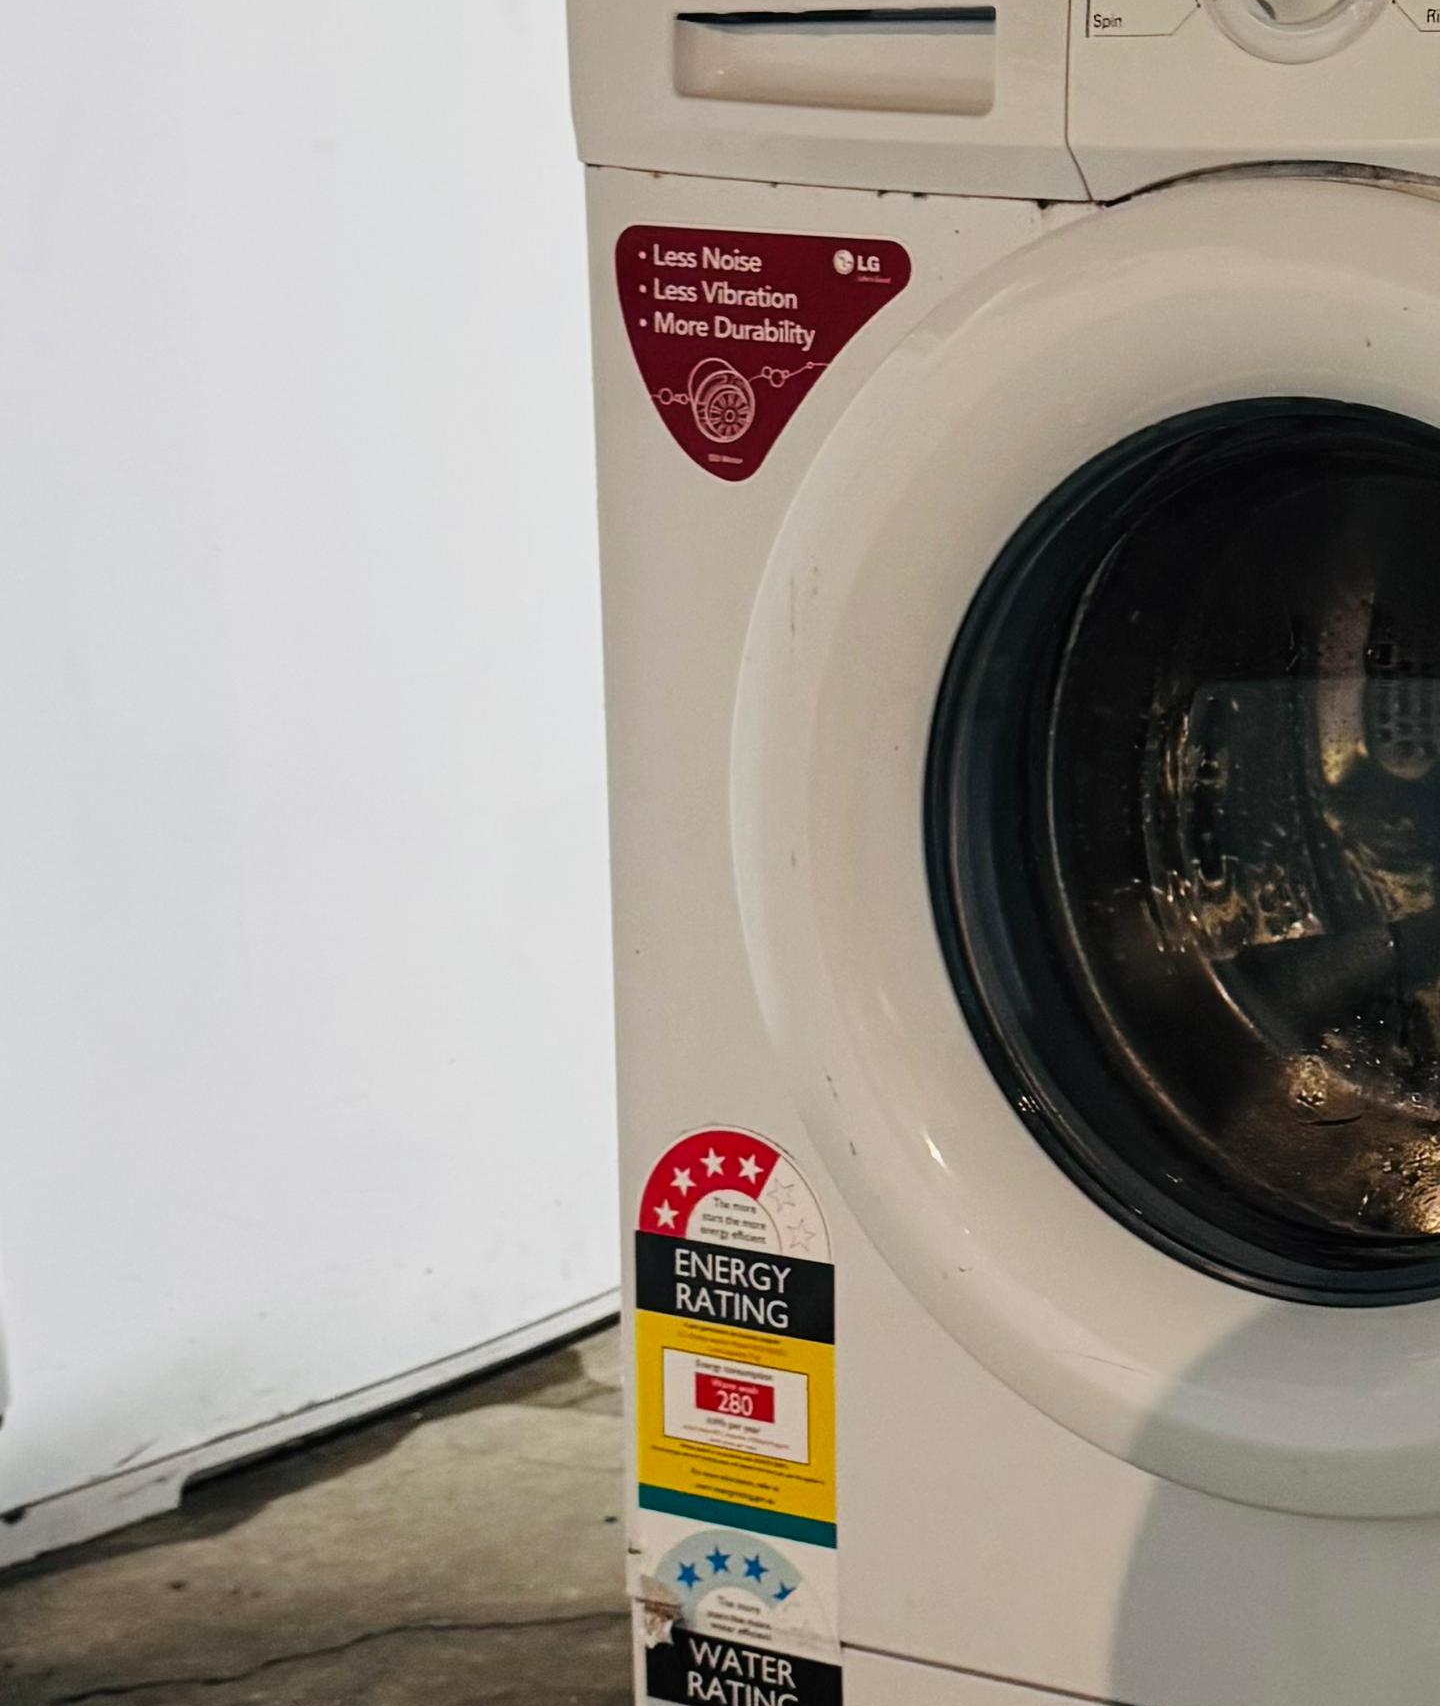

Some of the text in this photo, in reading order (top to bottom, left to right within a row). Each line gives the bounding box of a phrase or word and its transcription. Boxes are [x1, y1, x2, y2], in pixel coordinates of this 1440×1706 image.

[1093, 14, 1122, 29] Spin
[653, 243, 762, 273] Less Noise
[857, 255, 880, 272] LG
[653, 277, 798, 310] Less Vibration
[654, 311, 816, 351] More Durability
[713, 1196, 756, 1214] The more
[742, 1220, 766, 1230] more
[674, 1248, 791, 1293] ENERGY
[676, 1282, 789, 1329] RATING
[716, 1389, 754, 1417] 280
[688, 1638, 796, 1689] WATER
